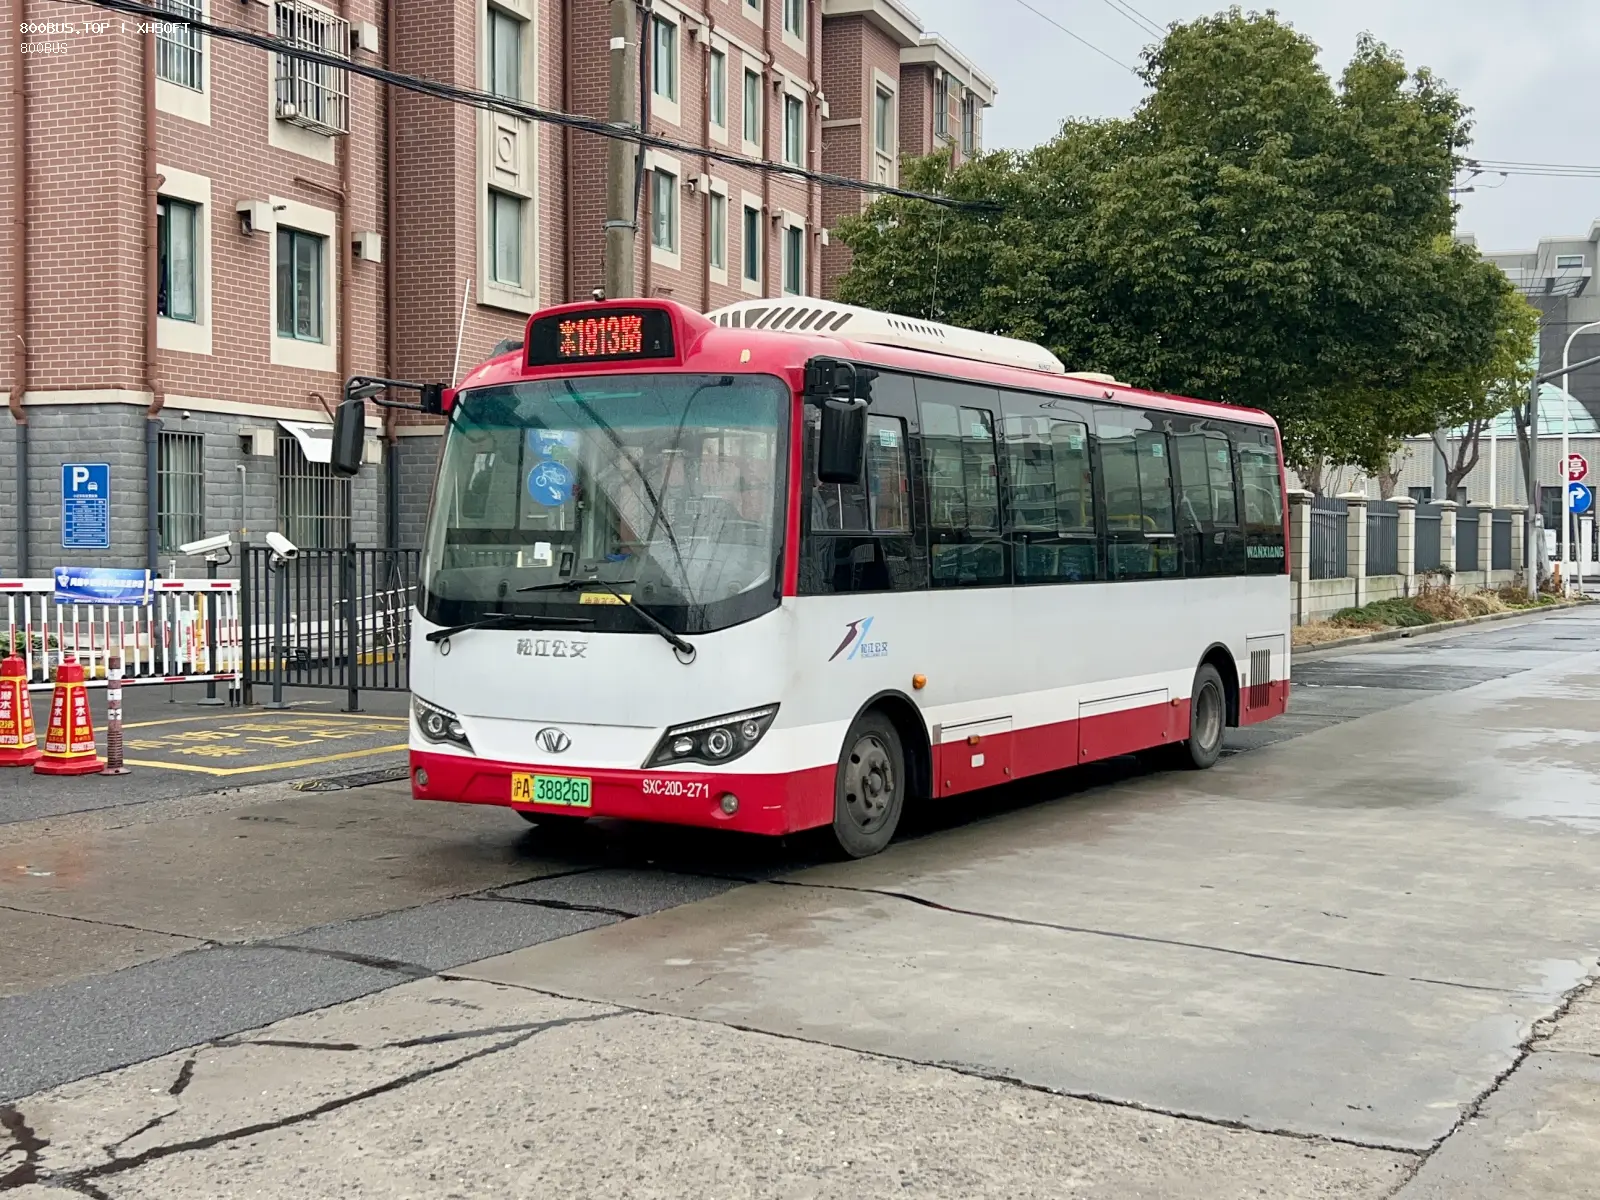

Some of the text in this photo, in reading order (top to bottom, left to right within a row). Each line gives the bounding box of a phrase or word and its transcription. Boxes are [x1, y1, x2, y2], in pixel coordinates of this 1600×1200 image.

[72, 466, 90, 492] P
[1246, 545, 1285, 559] WANXIANG
[516, 638, 589, 659] 松江公交
[860, 641, 889, 654] 松江公交
[642, 778, 710, 798] SXC-20D-271
